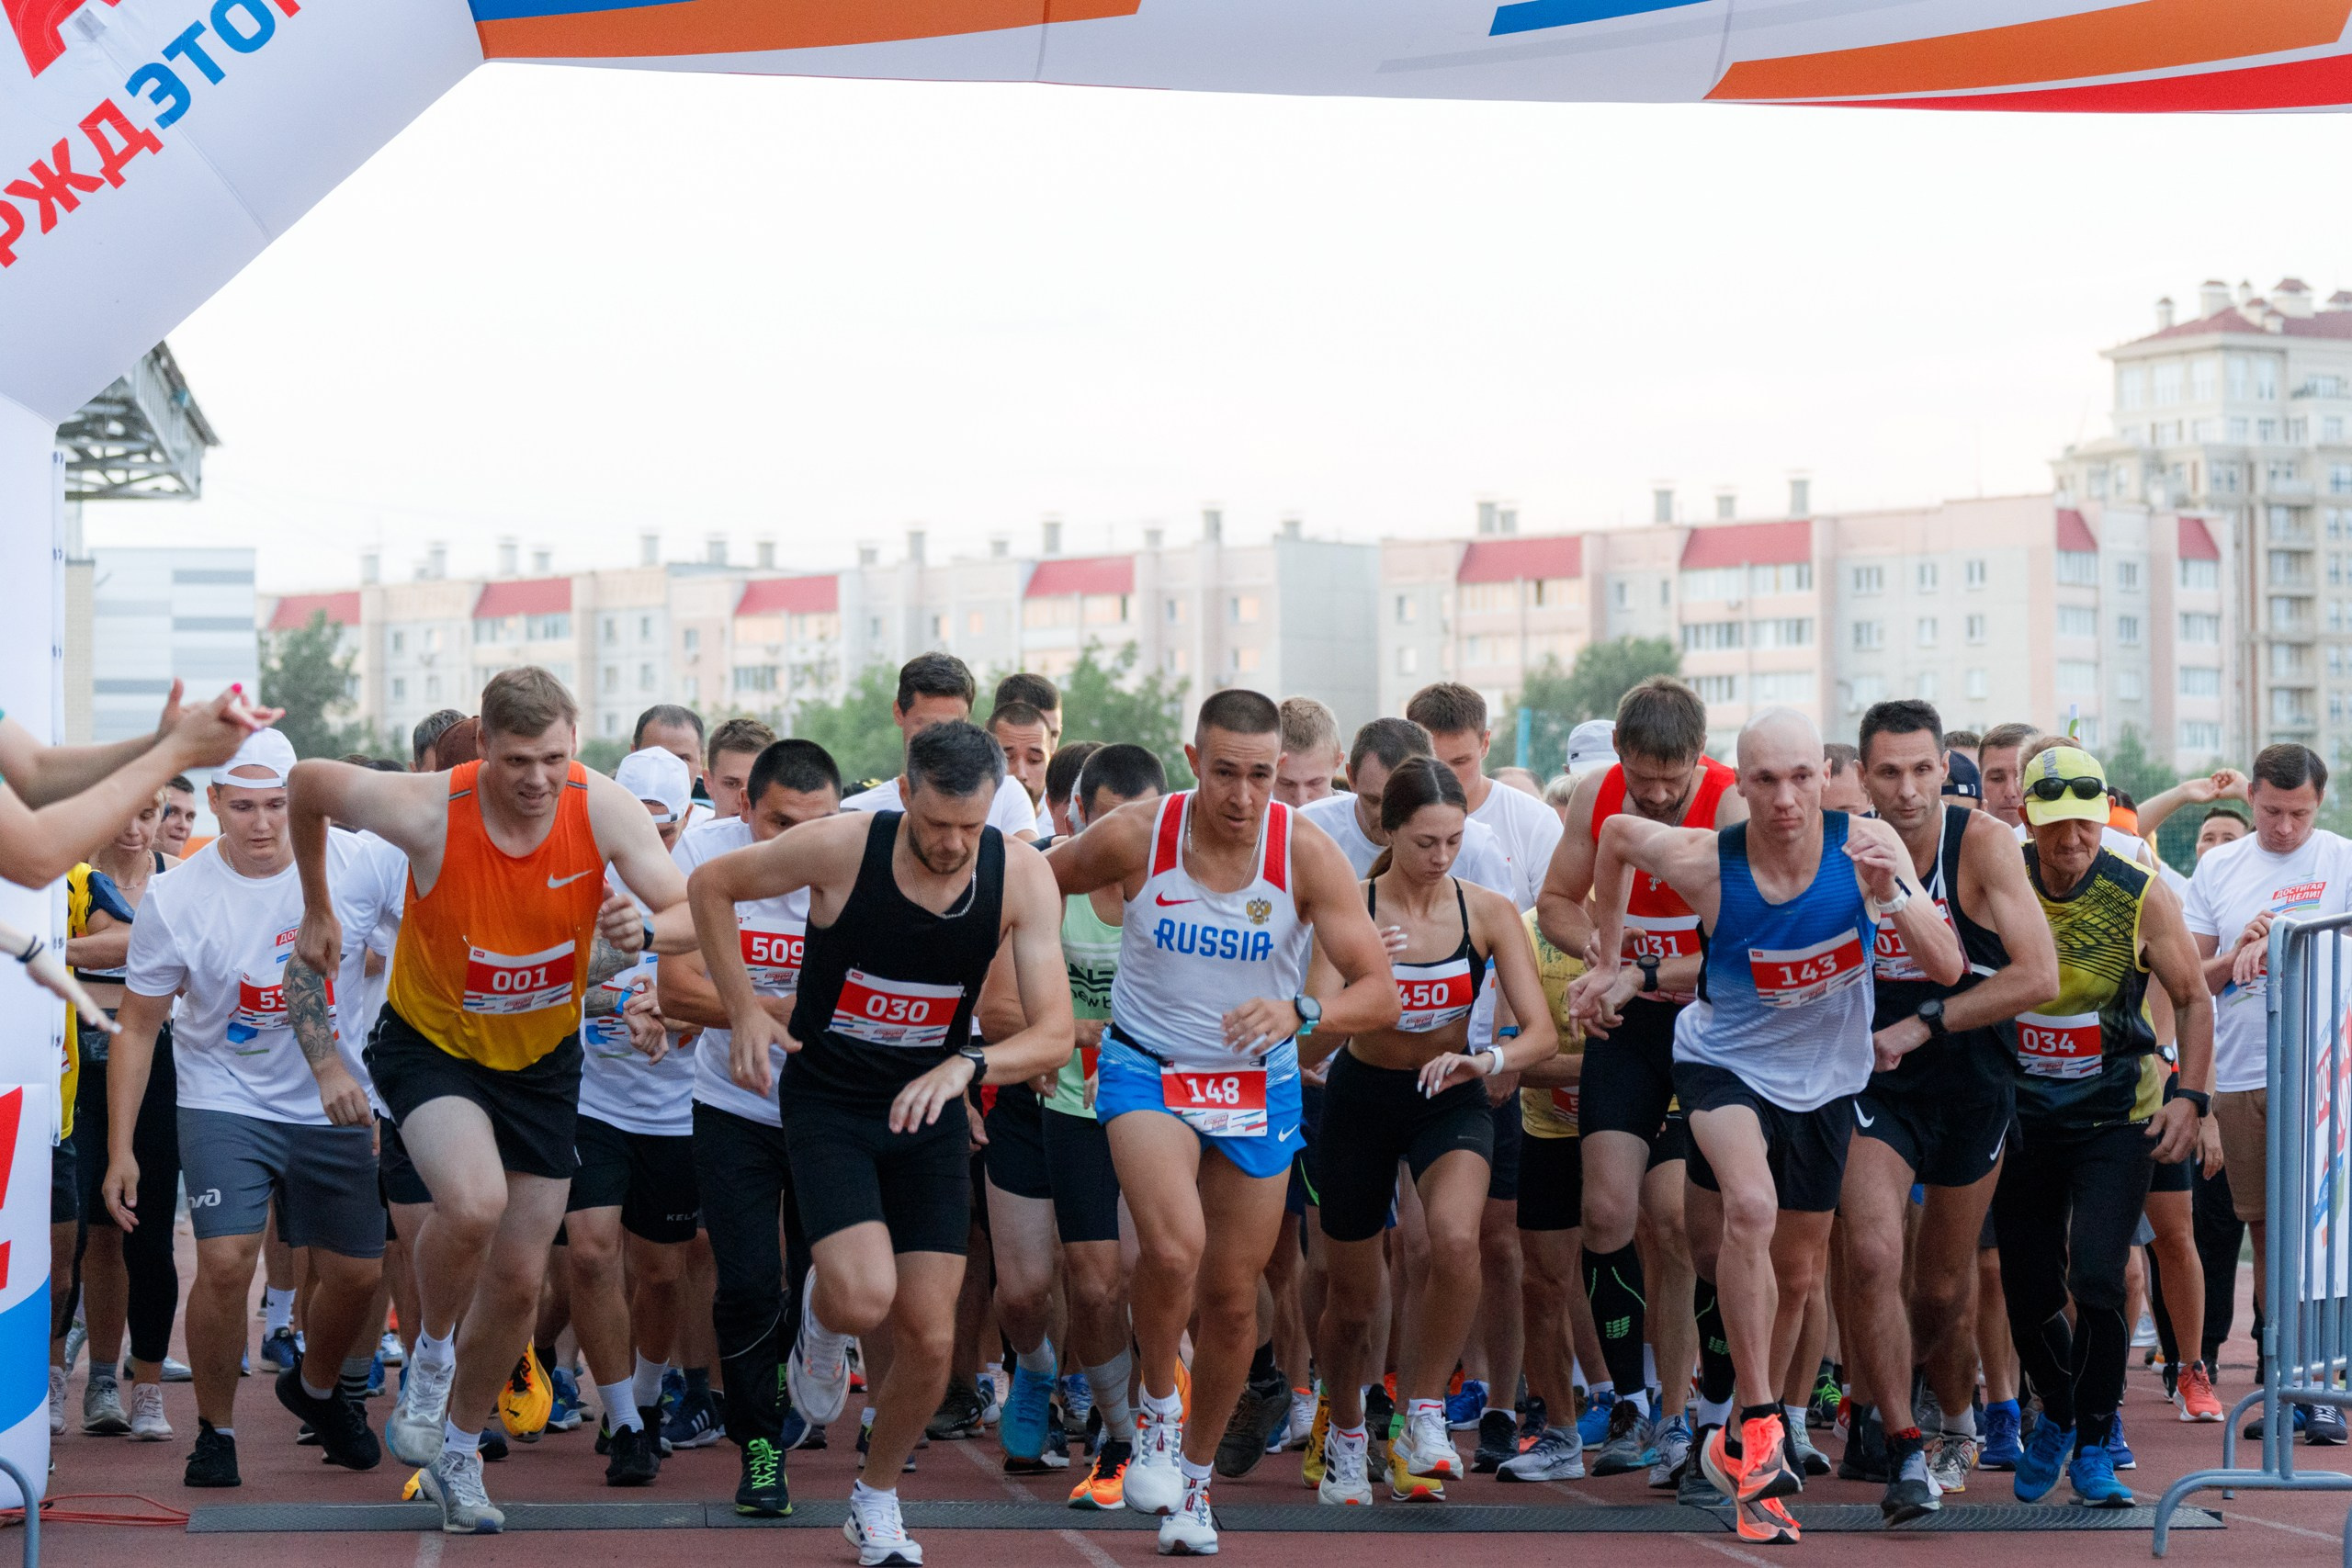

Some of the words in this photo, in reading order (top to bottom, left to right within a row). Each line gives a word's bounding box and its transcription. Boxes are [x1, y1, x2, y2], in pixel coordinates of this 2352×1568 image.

[2276, 883, 2324, 899] ДОСТИГАЯ
[2288, 890, 2321, 903] ЦЕЛИ!
[752, 937, 804, 965] 509
[1153, 918, 1273, 961] RUSSIA
[1634, 935, 1682, 959] 031
[1876, 932, 1907, 954] 01
[492, 966, 548, 992] 001
[1779, 953, 1838, 987] 143
[1398, 983, 1449, 1007] 450
[865, 995, 930, 1022] 030
[2023, 1028, 2076, 1054] 034
[1186, 1077, 1239, 1104] 148
